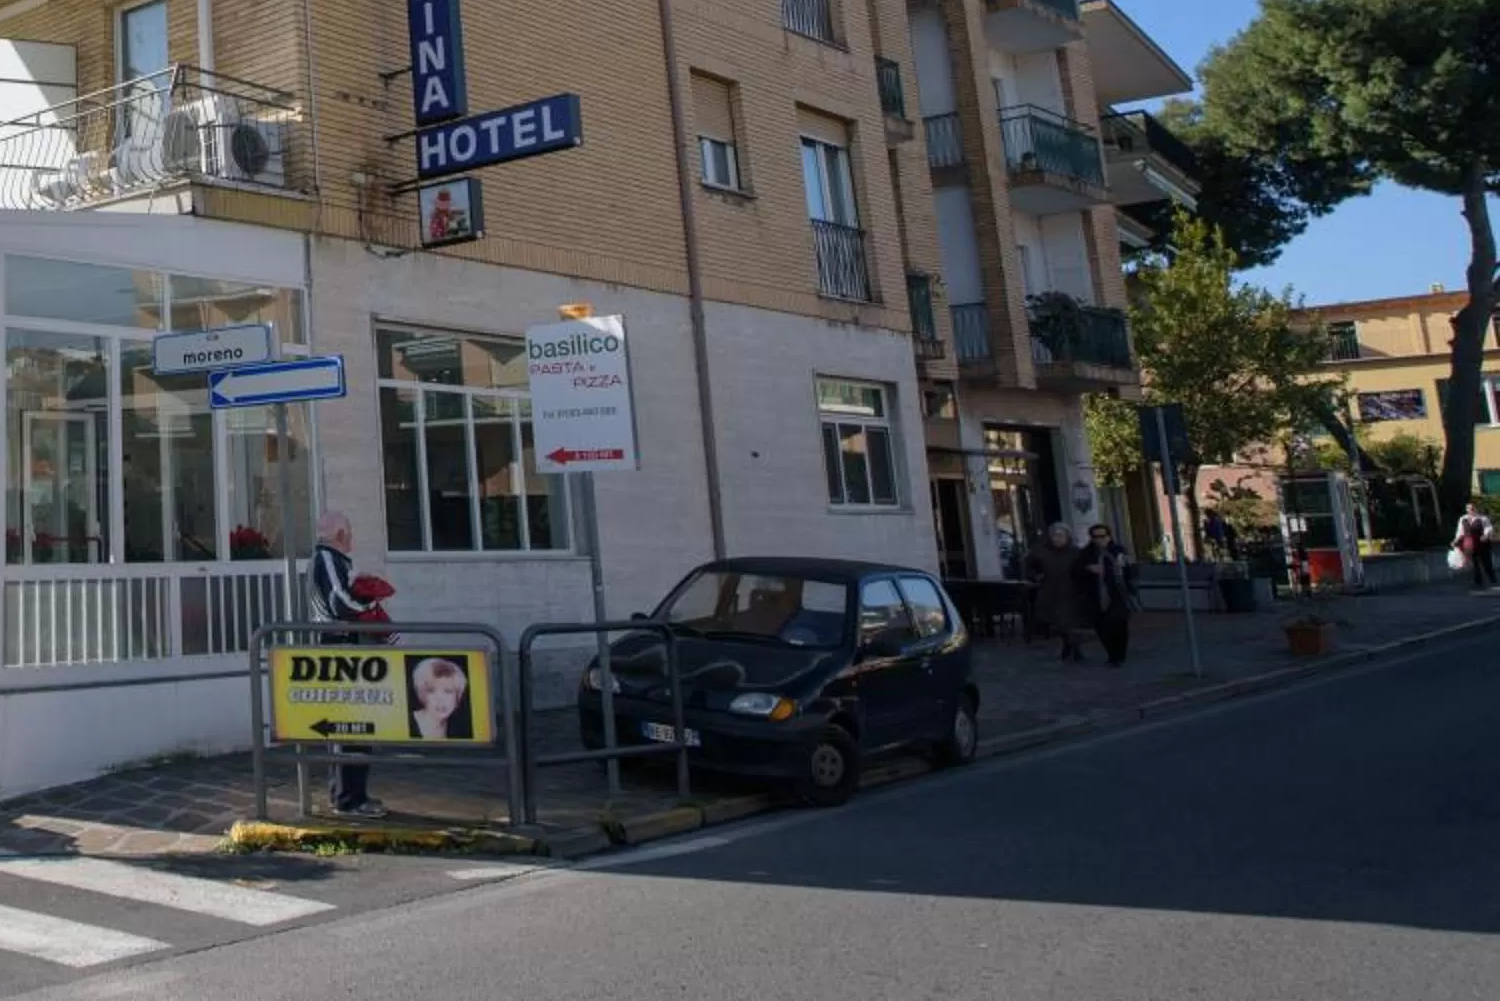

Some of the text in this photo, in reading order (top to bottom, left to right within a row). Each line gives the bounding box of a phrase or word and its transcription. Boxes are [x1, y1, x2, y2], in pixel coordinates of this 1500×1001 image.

[421, 106, 565, 170] HOTEL
[183, 348, 243, 365] moreno
[528, 333, 619, 359] basilico
[530, 362, 585, 375] PASTA
[573, 375, 622, 388] PIZZA
[289, 656, 389, 682] DINO
